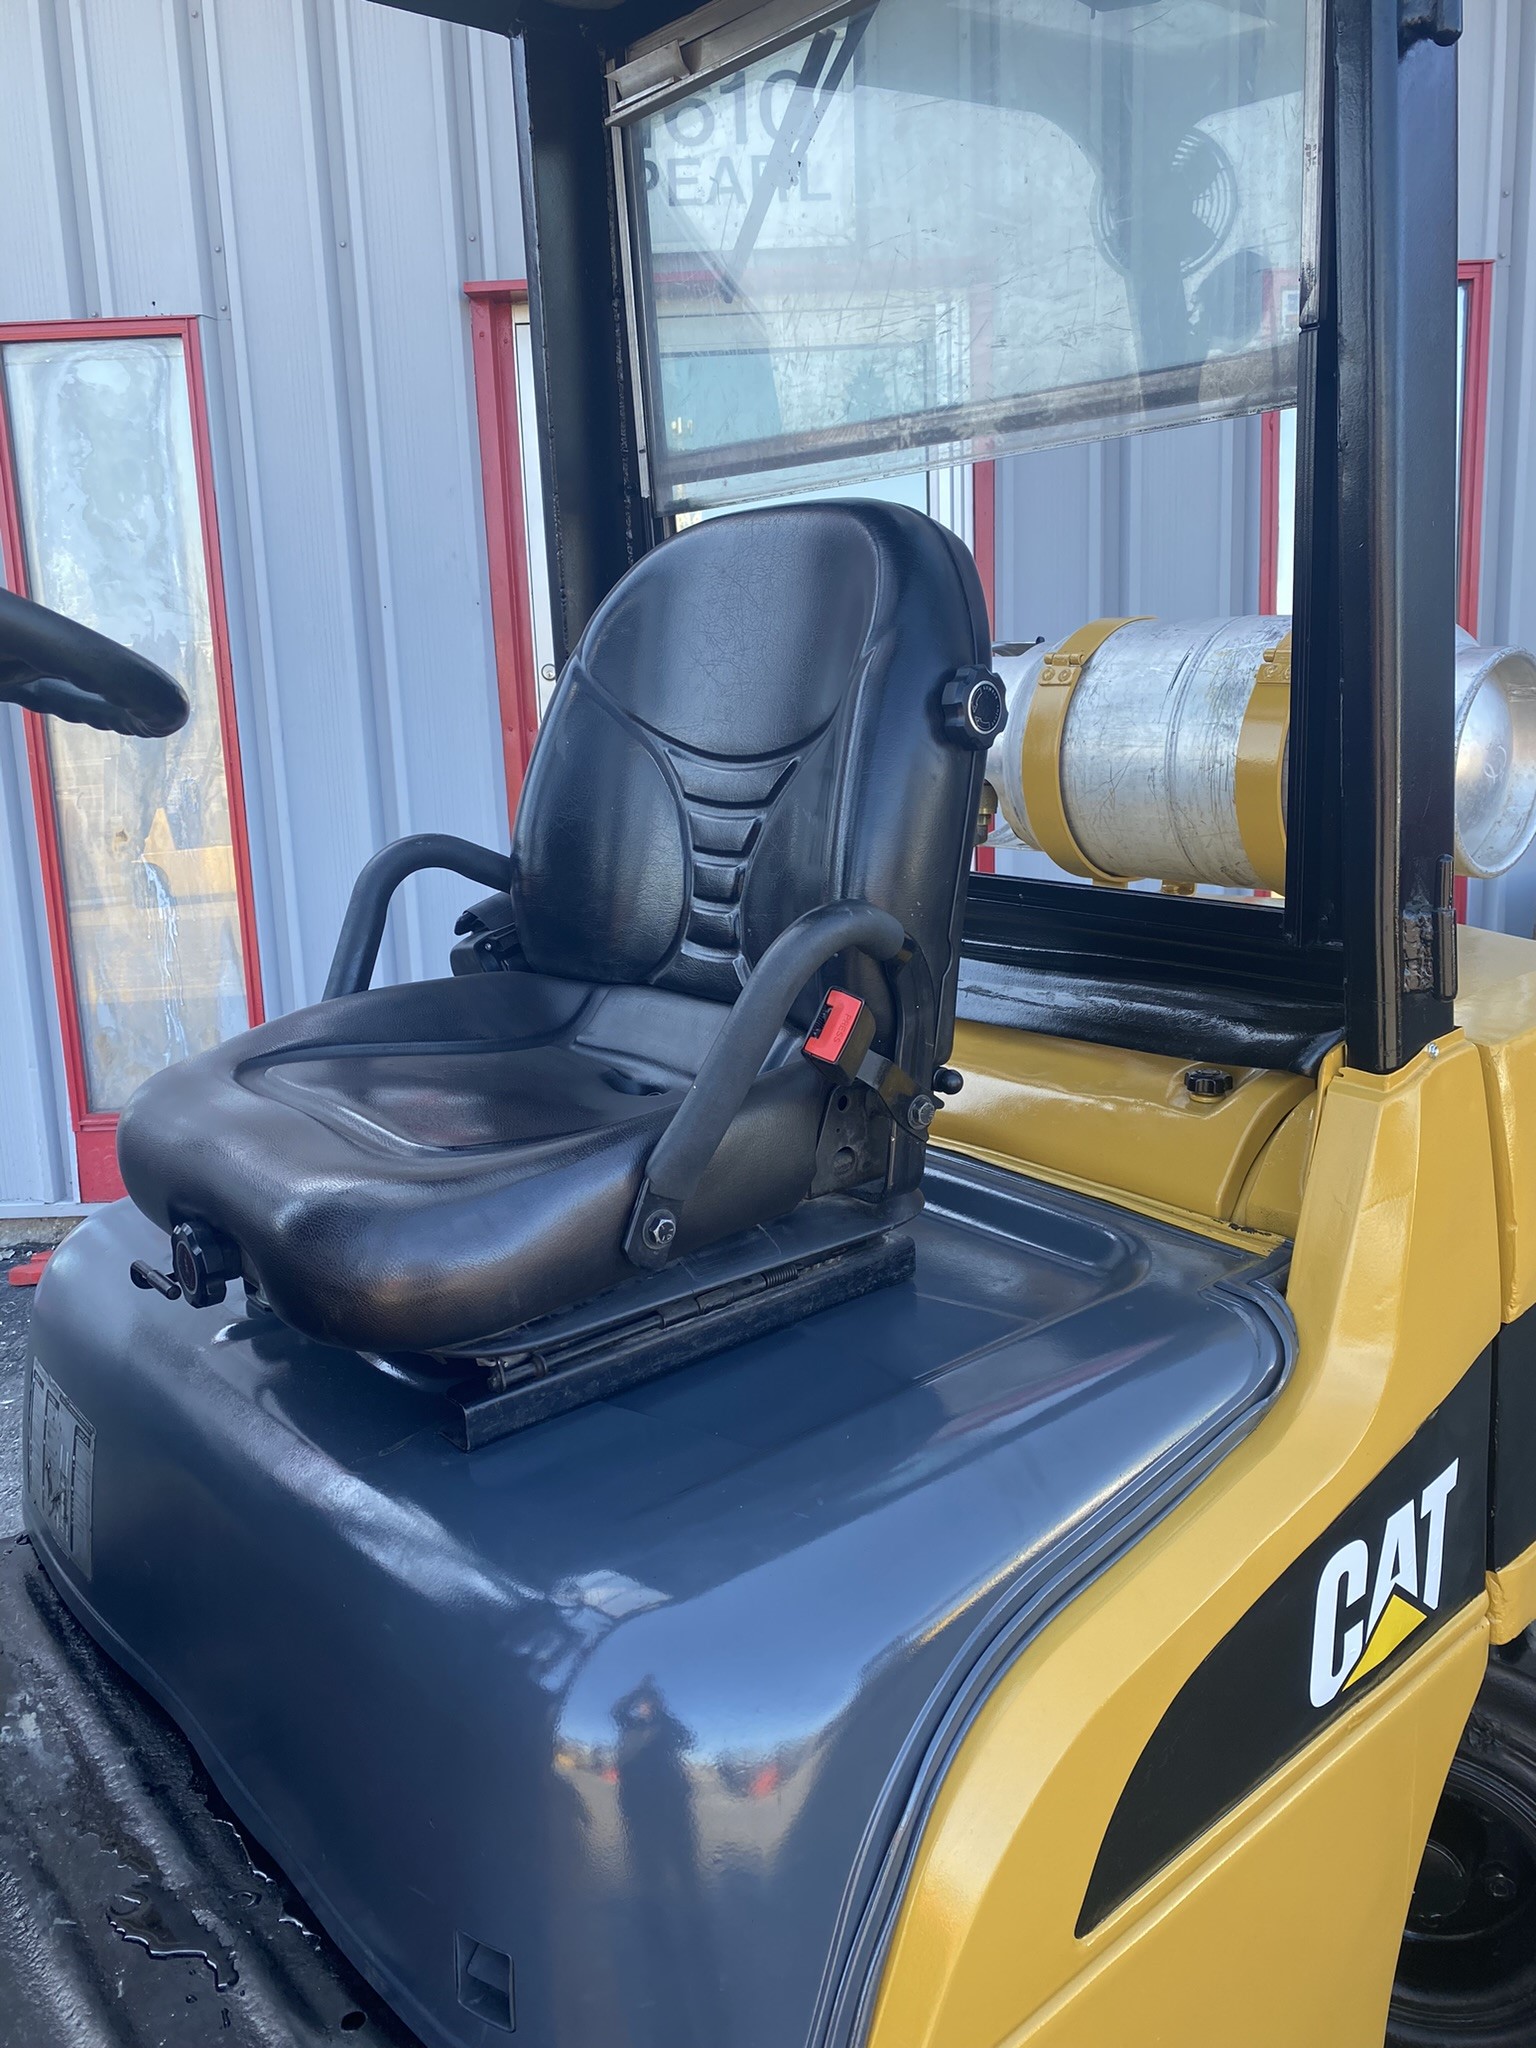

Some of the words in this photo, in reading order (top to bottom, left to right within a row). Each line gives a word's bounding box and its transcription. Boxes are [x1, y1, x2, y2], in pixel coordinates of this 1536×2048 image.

[643, 69, 814, 149] 610
[833, 1013, 852, 1043] PRESS
[1309, 1457, 1459, 1708] CAT
